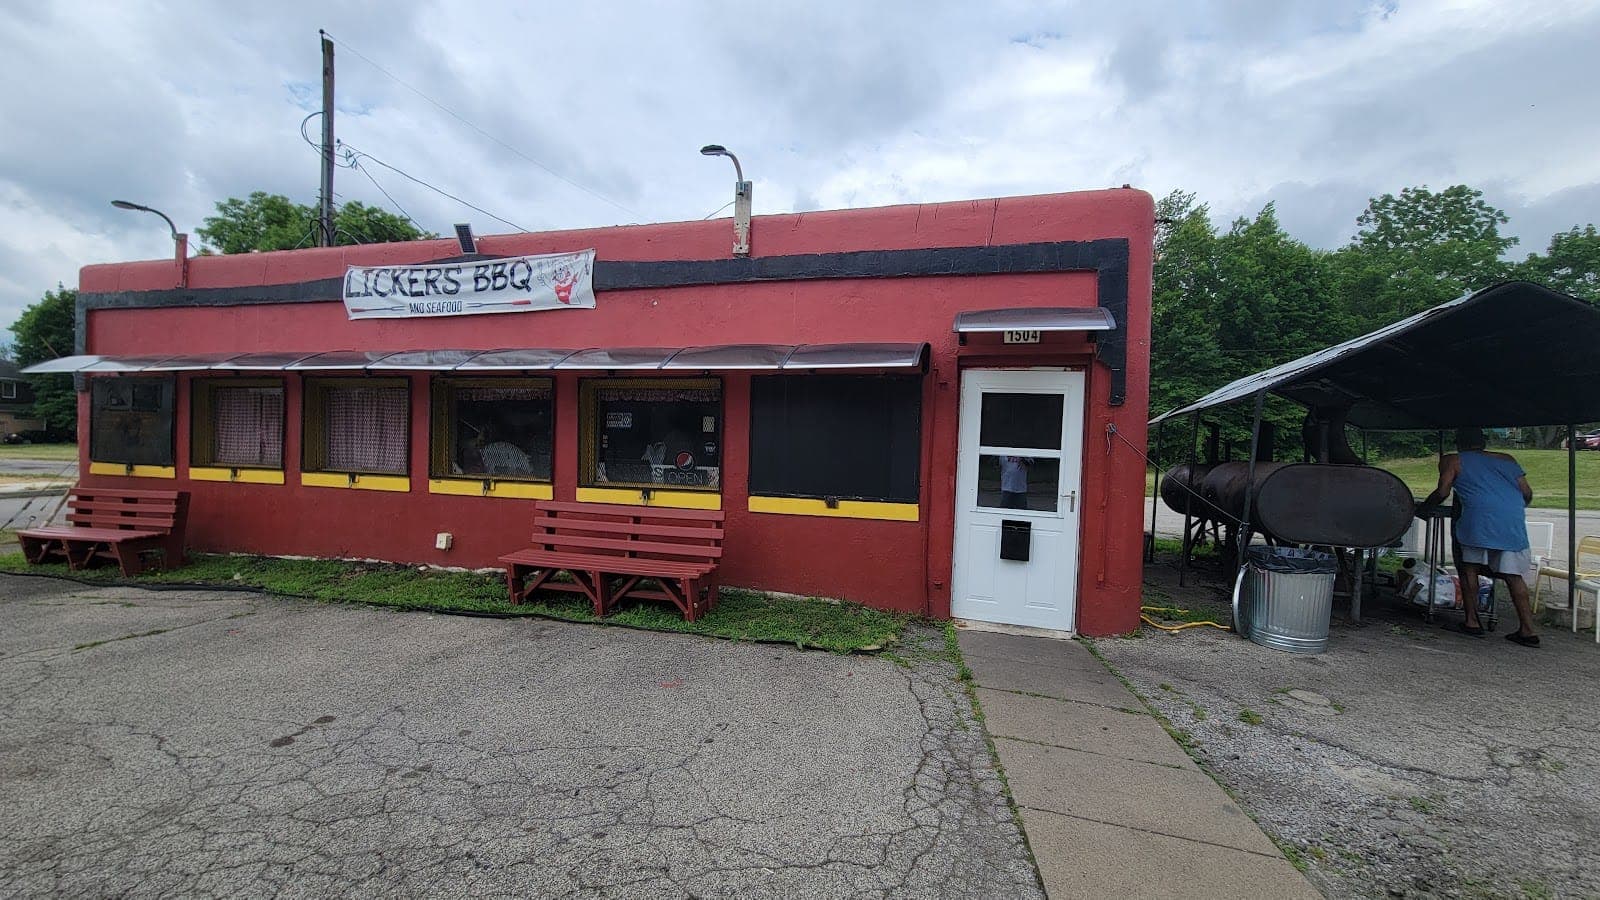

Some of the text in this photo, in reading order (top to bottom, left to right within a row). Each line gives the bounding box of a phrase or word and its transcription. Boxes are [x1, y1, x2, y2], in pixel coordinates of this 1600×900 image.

[345, 259, 533, 297] LICKERS BBQ
[409, 300, 463, 314] AND SEAFOOD
[1007, 330, 1038, 341] 1504
[668, 471, 703, 484] OPEN
